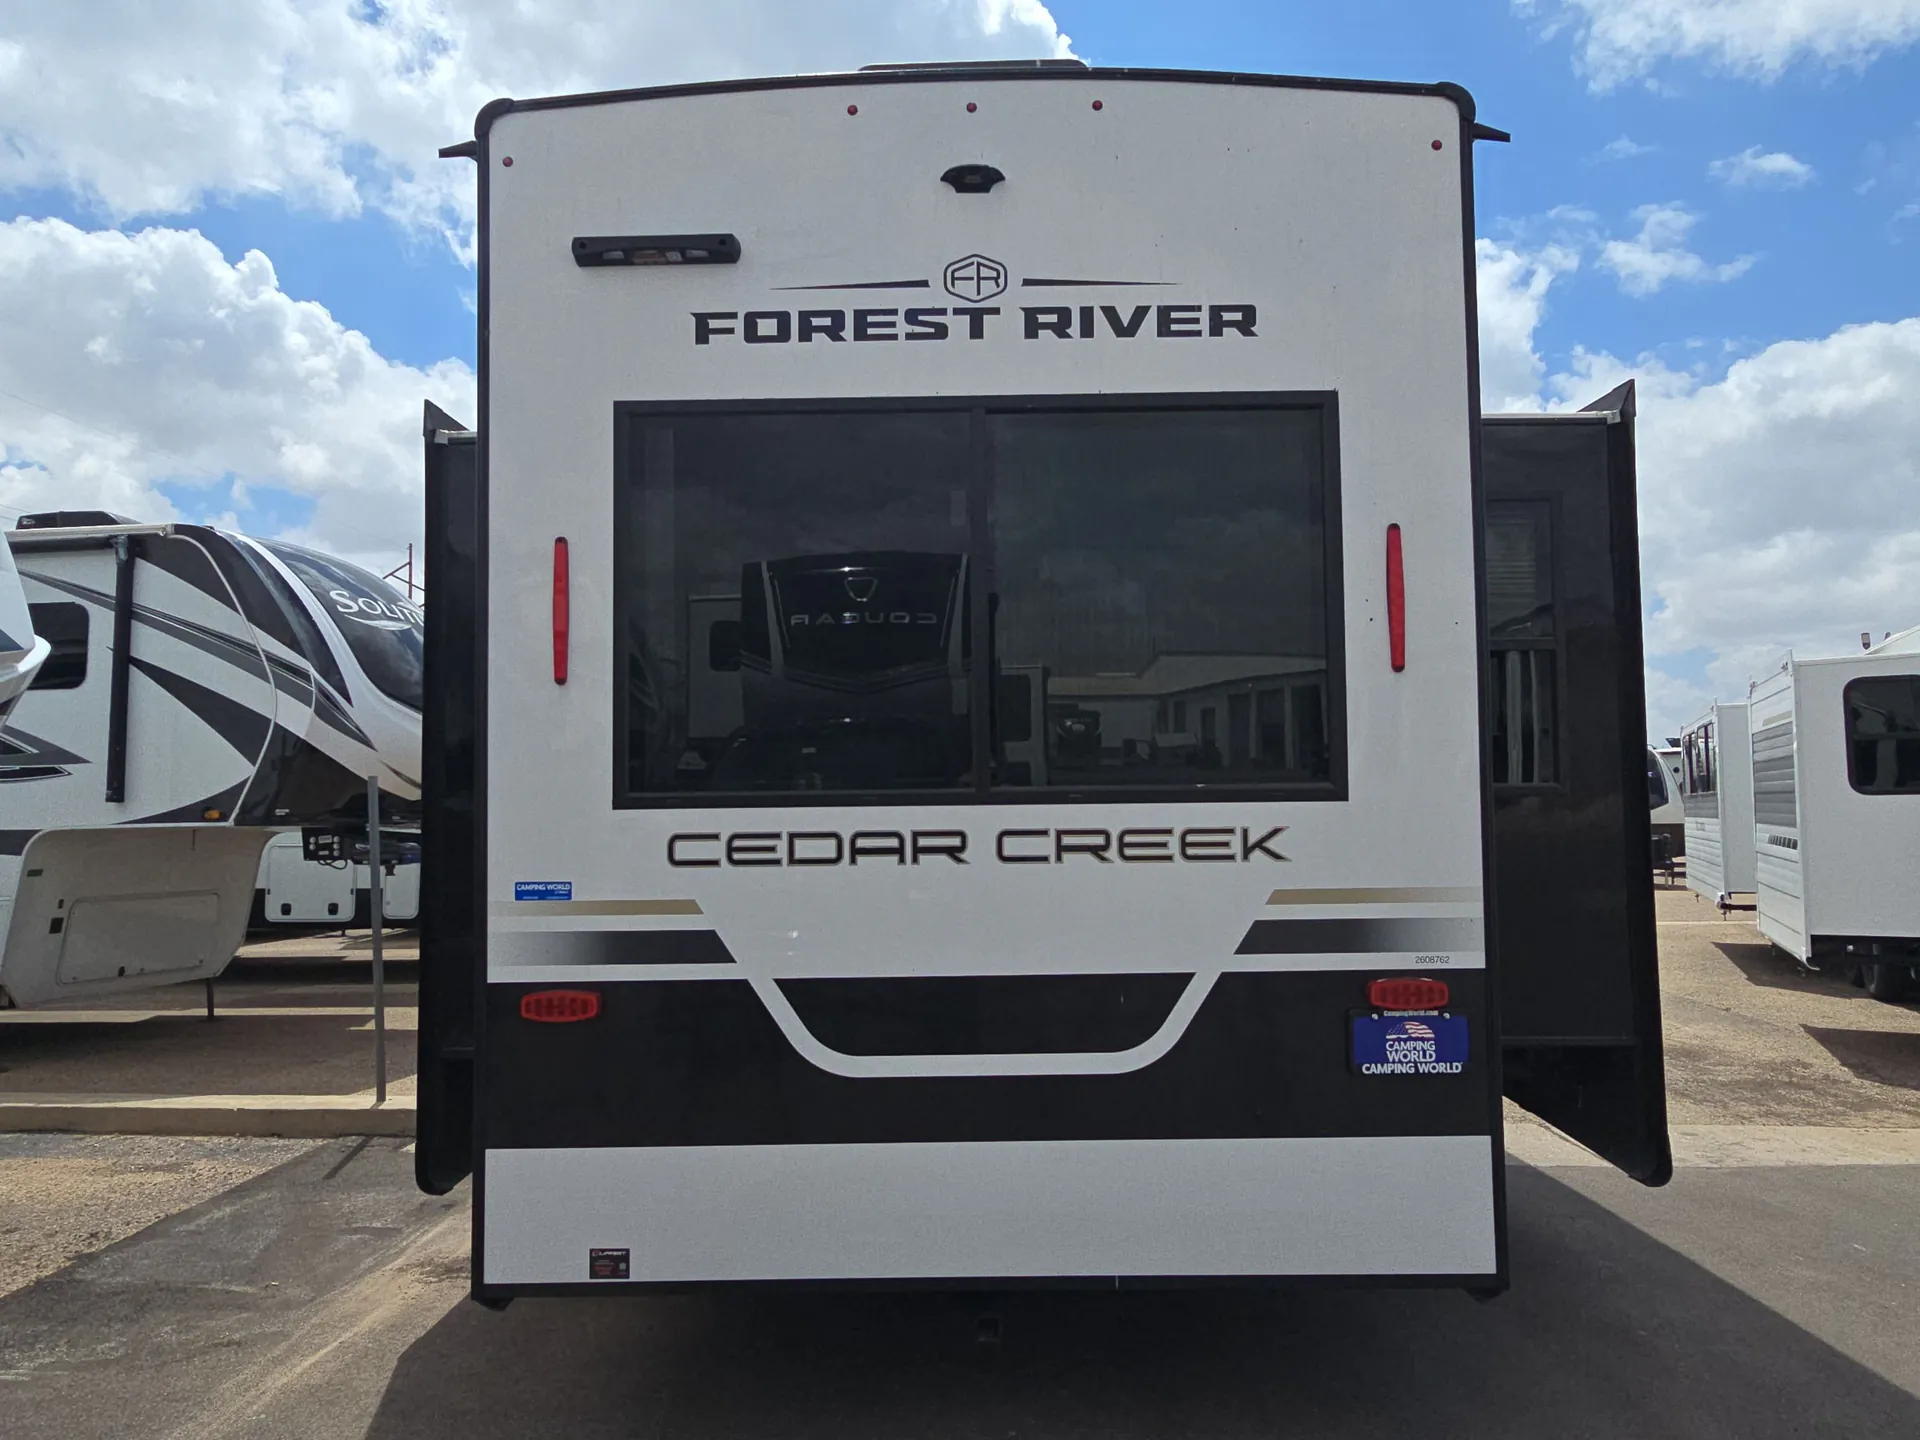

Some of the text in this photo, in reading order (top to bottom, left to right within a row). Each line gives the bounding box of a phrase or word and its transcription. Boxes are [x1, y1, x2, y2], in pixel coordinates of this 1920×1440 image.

[689, 304, 1259, 346] FOREST RIVER
[667, 826, 1293, 868] CEDAR CREEK
[1415, 955, 1450, 964] 2608762
[1386, 1041, 1436, 1050] CAMPING
[1386, 1051, 1436, 1062] WORLD
[1362, 1063, 1462, 1074] CAMPING WORLD
